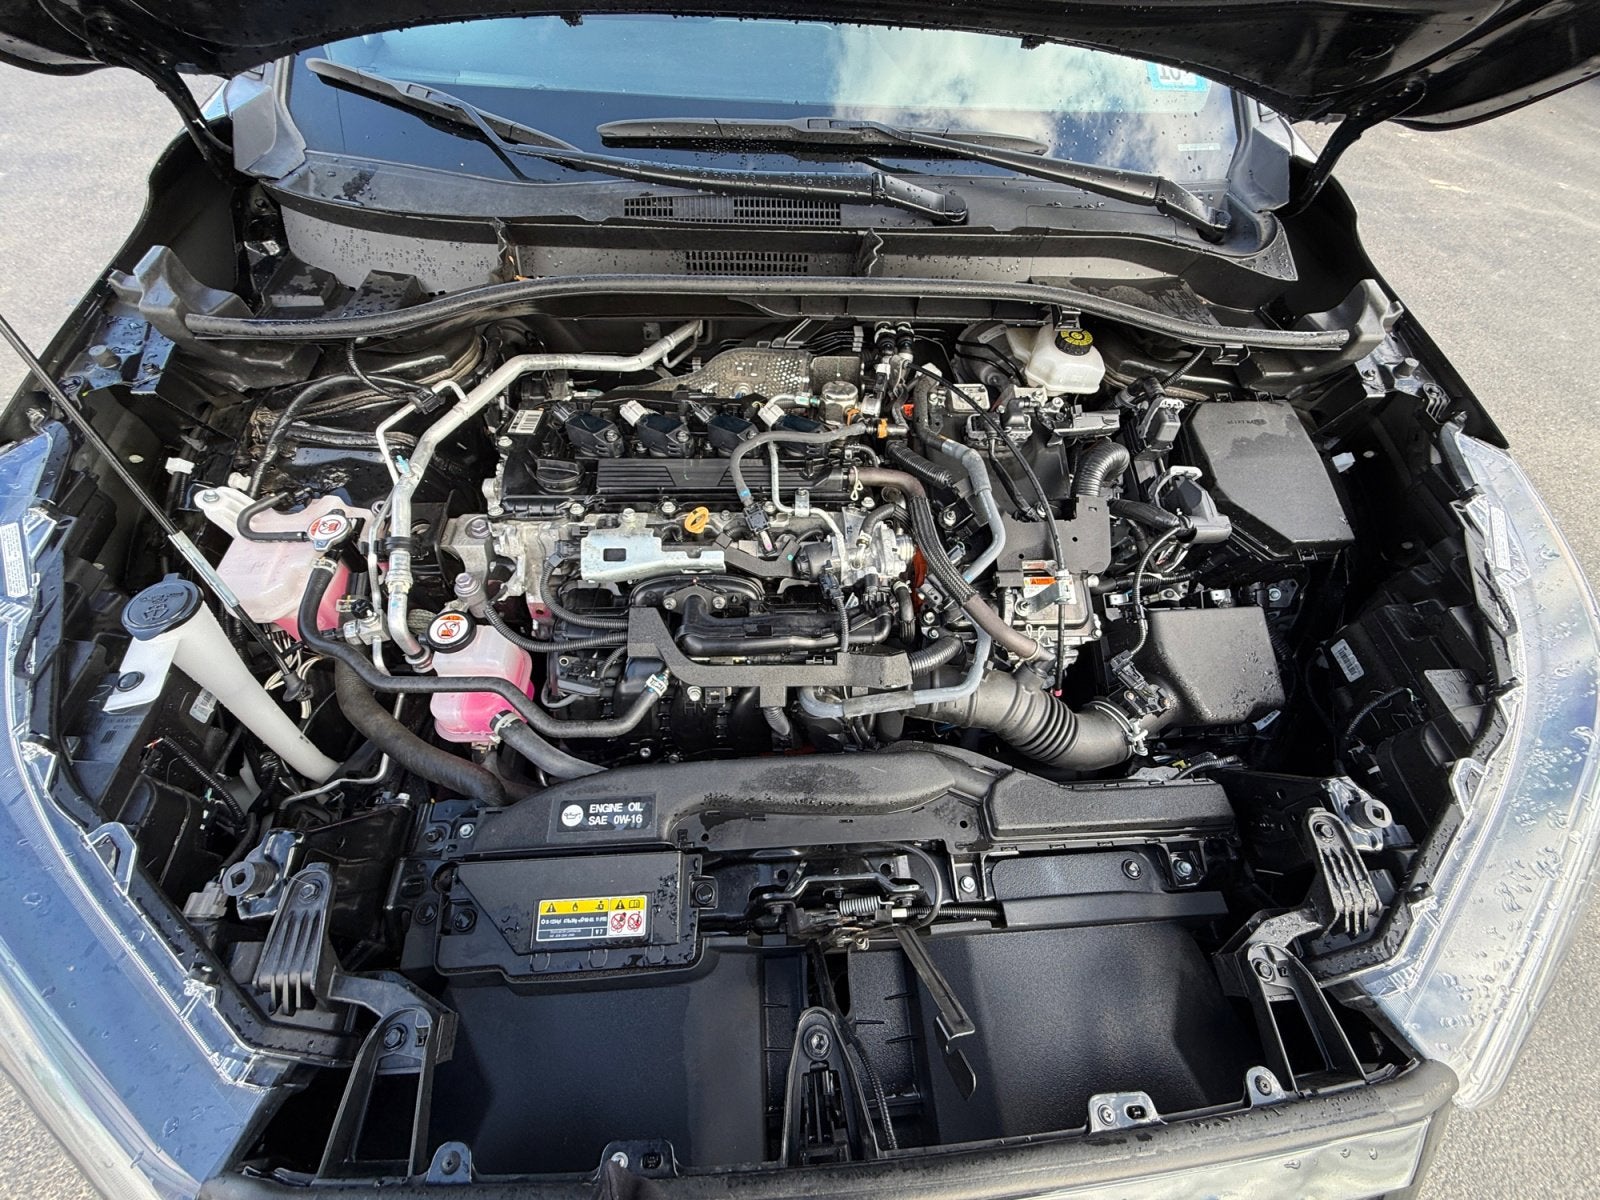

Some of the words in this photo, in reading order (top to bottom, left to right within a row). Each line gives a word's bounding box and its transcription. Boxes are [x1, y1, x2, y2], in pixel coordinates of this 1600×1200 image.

[589, 803, 623, 814] ENGINE
[628, 801, 644, 812] OIL
[588, 815, 608, 826] SAE
[613, 814, 643, 825] 0W-16
